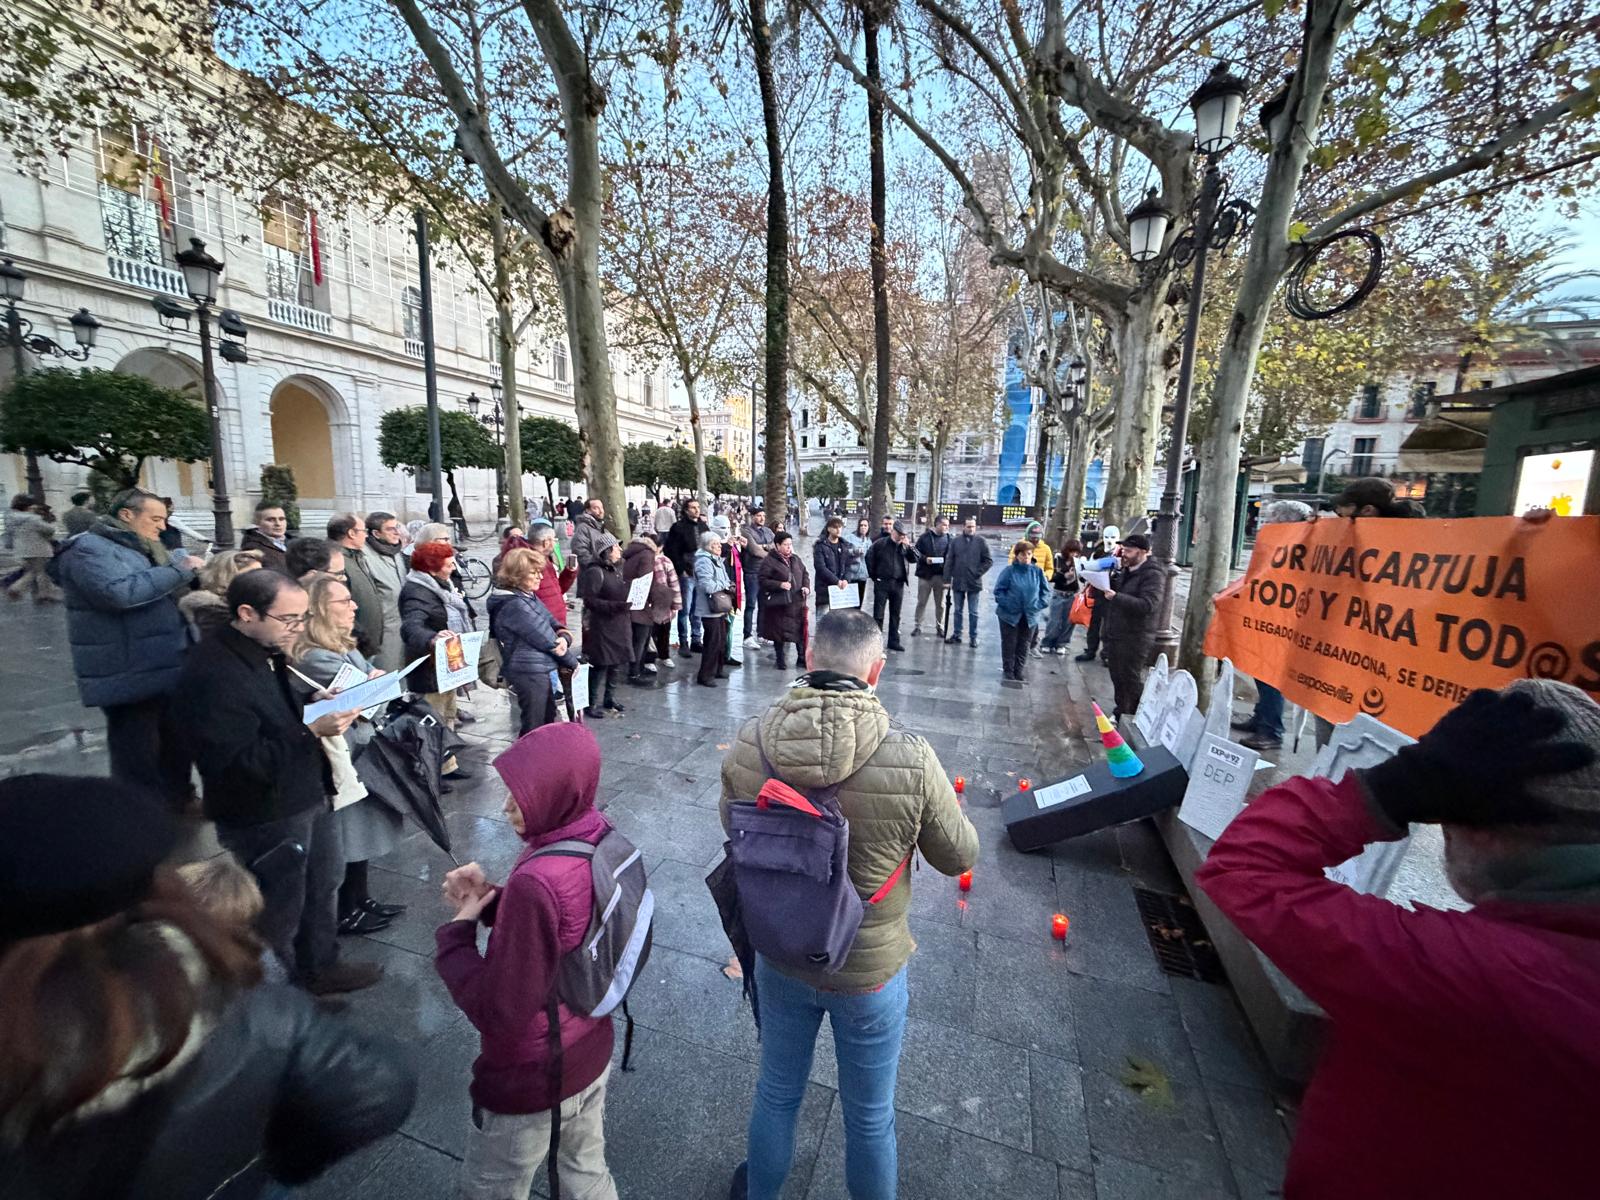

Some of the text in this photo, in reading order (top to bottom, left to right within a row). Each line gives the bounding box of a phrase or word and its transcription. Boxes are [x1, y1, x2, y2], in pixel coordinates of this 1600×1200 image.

[1319, 590, 1338, 620] Y
[1344, 596, 1418, 647] PARA
[1243, 616, 1252, 629] EL
[1254, 619, 1293, 641] LEGADO
[1313, 641, 1392, 683] ABANDONA,
[1396, 667, 1418, 688] SE
[1421, 675, 1468, 704] DEFIE
[1203, 763, 1235, 786] DEP
